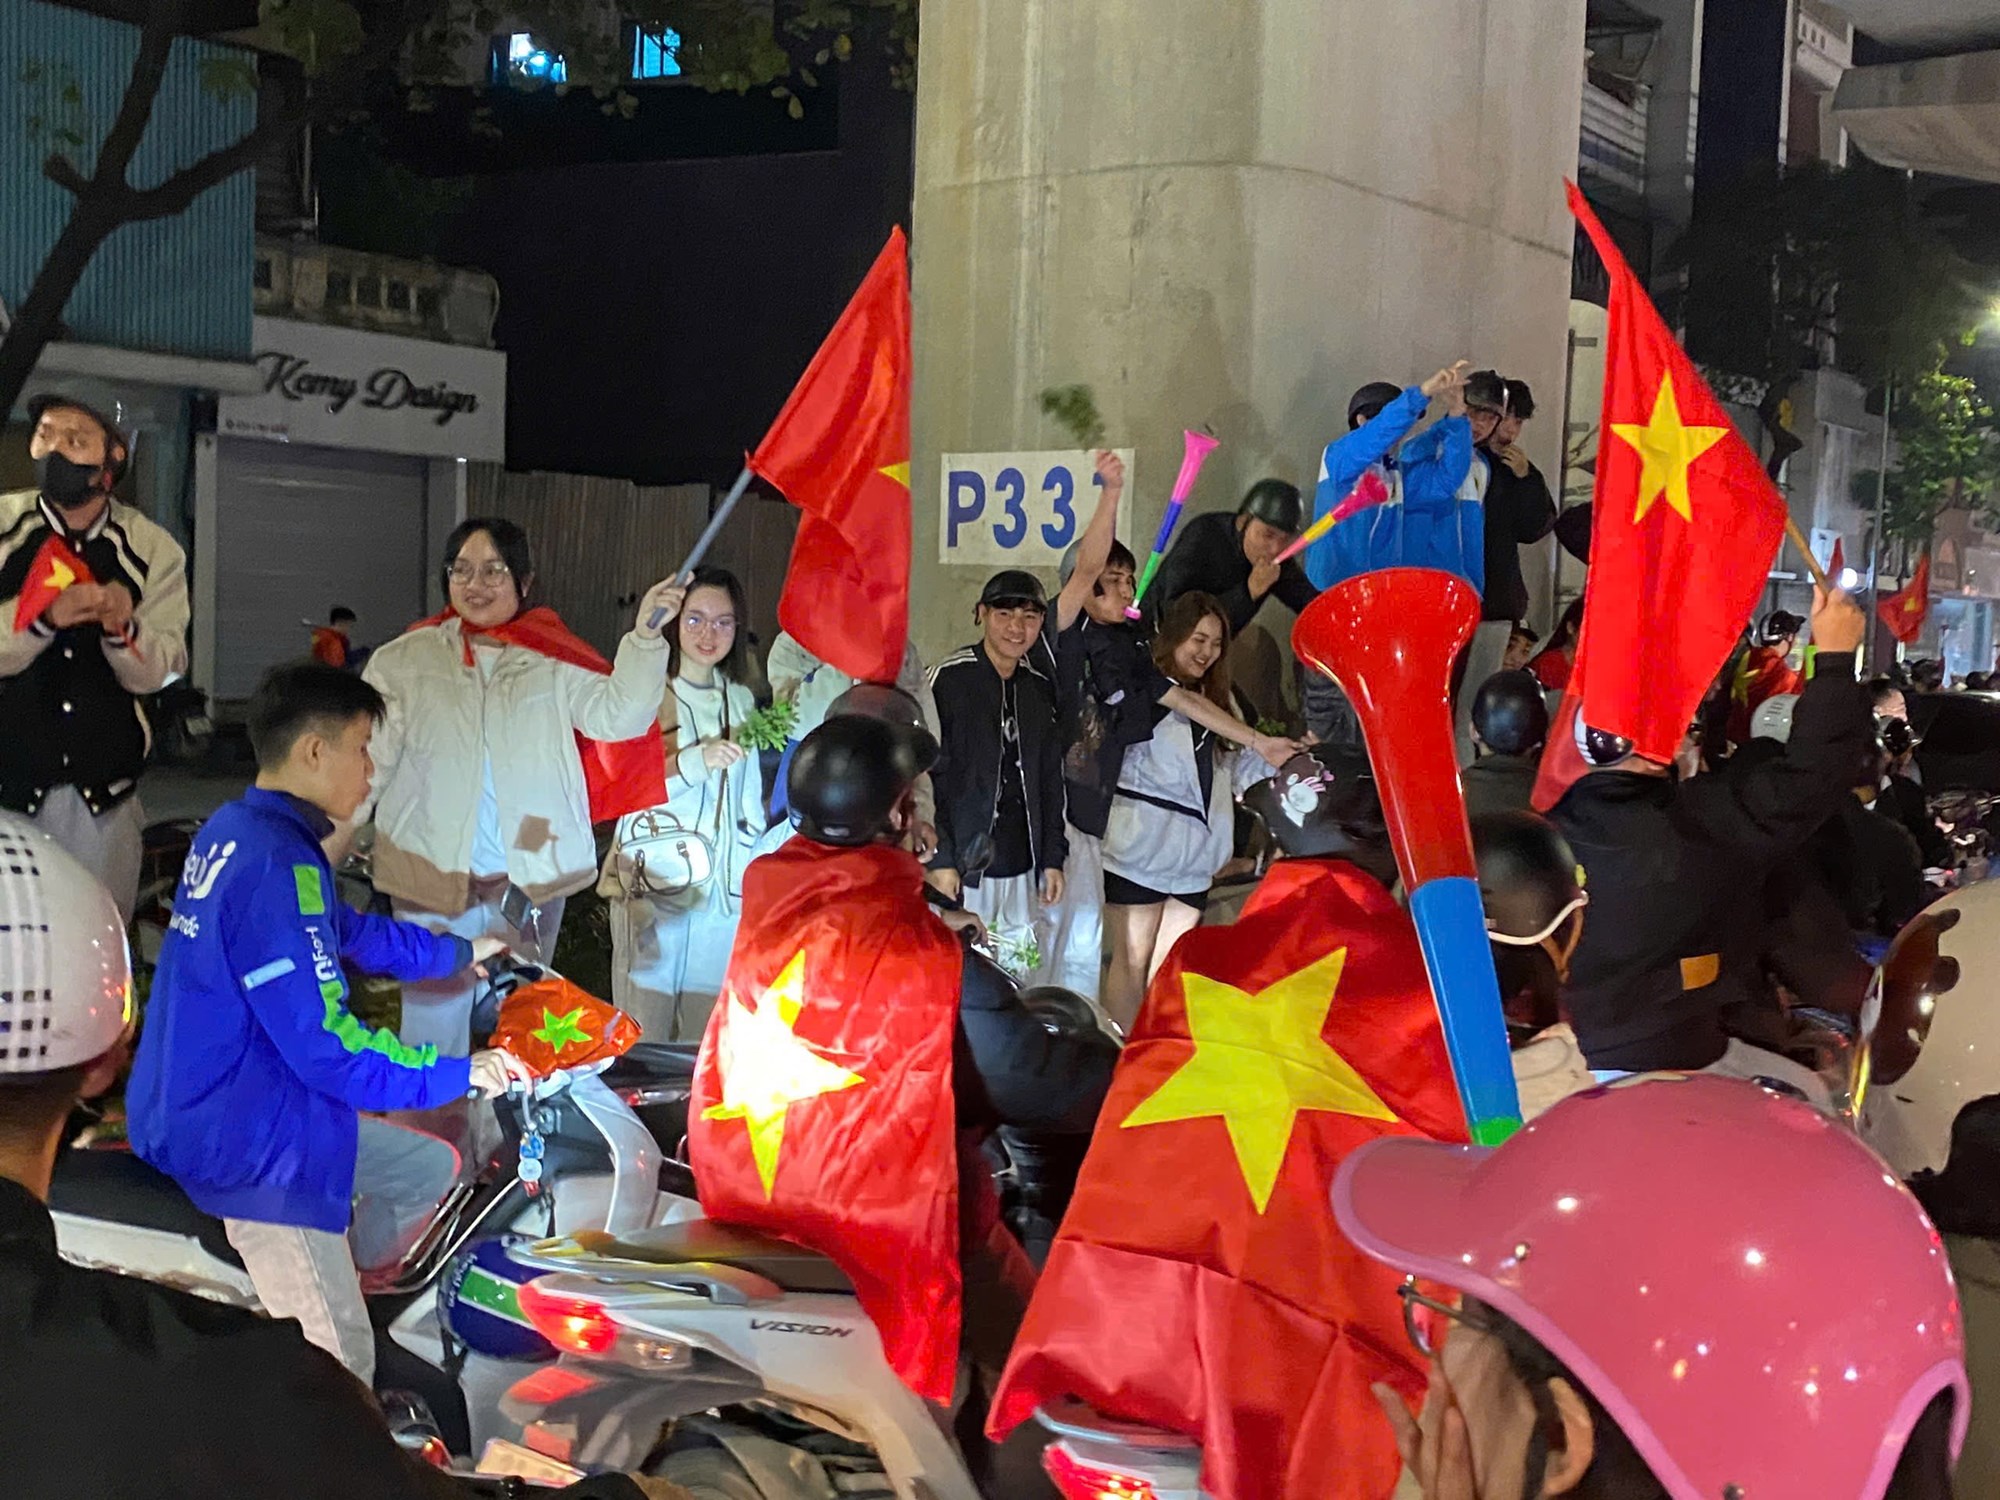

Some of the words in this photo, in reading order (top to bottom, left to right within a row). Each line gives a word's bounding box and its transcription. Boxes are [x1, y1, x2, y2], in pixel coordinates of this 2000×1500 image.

[361, 367, 478, 426] Design
[947, 465, 1116, 549] P33
[750, 1318, 855, 1338] VISION
